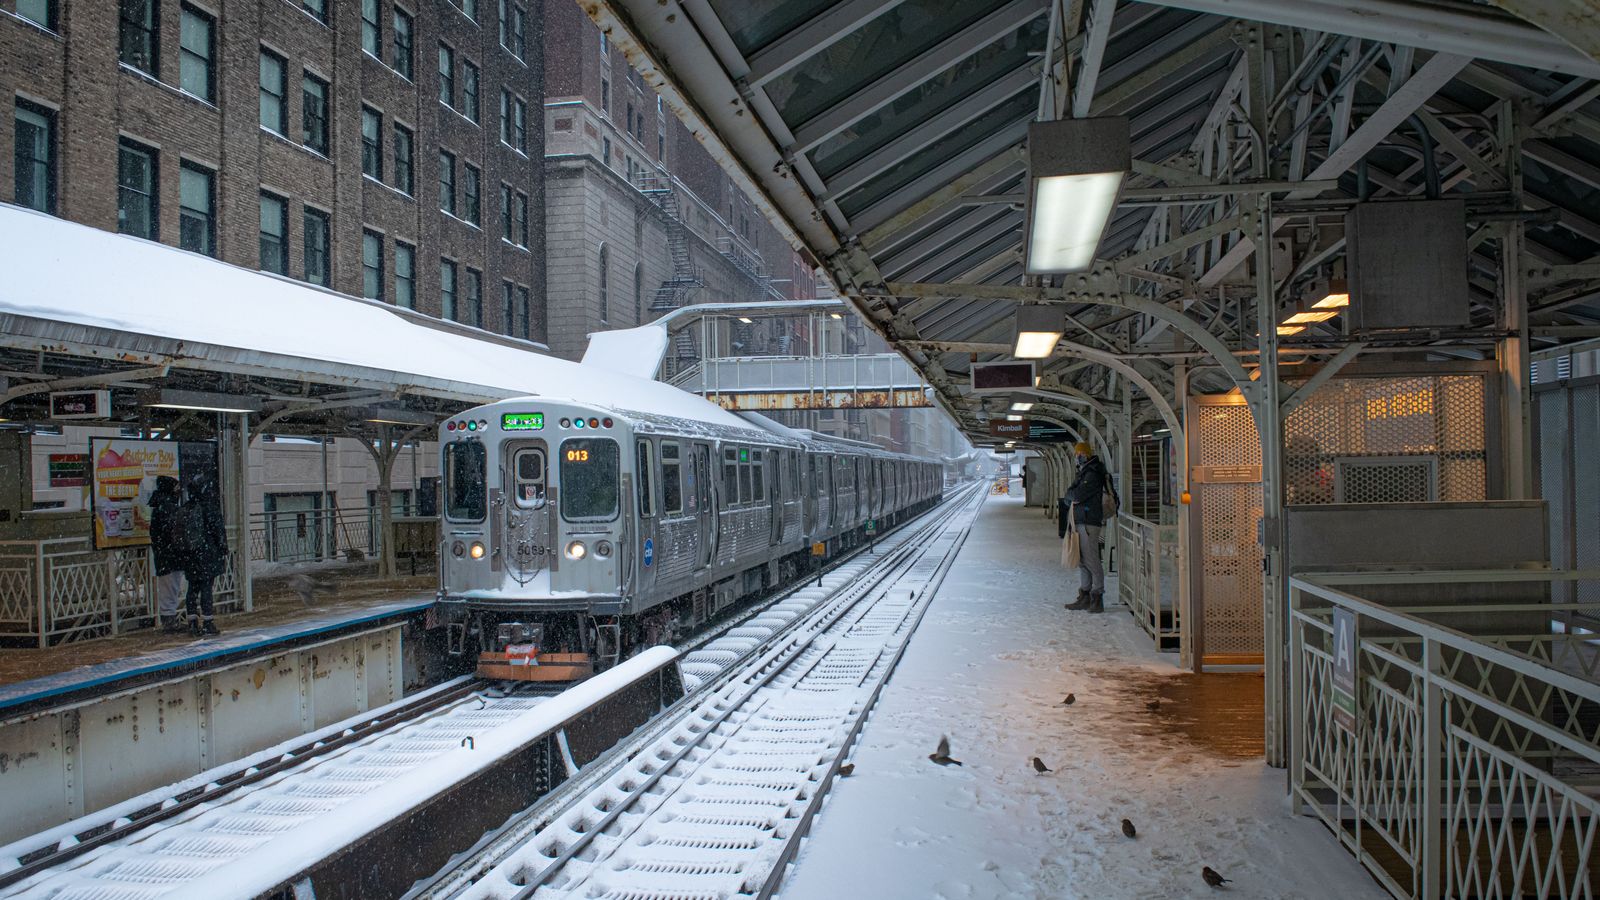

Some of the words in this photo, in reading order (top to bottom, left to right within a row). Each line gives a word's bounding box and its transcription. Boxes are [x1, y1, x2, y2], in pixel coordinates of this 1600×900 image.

[997, 424, 1023, 432] Kimball
[124, 446, 156, 462] Butcher
[158, 448, 174, 467] Boy
[567, 450, 588, 461] 013
[105, 485, 116, 496] THE
[517, 545, 545, 556] 5069
[1337, 618, 1350, 673] A
